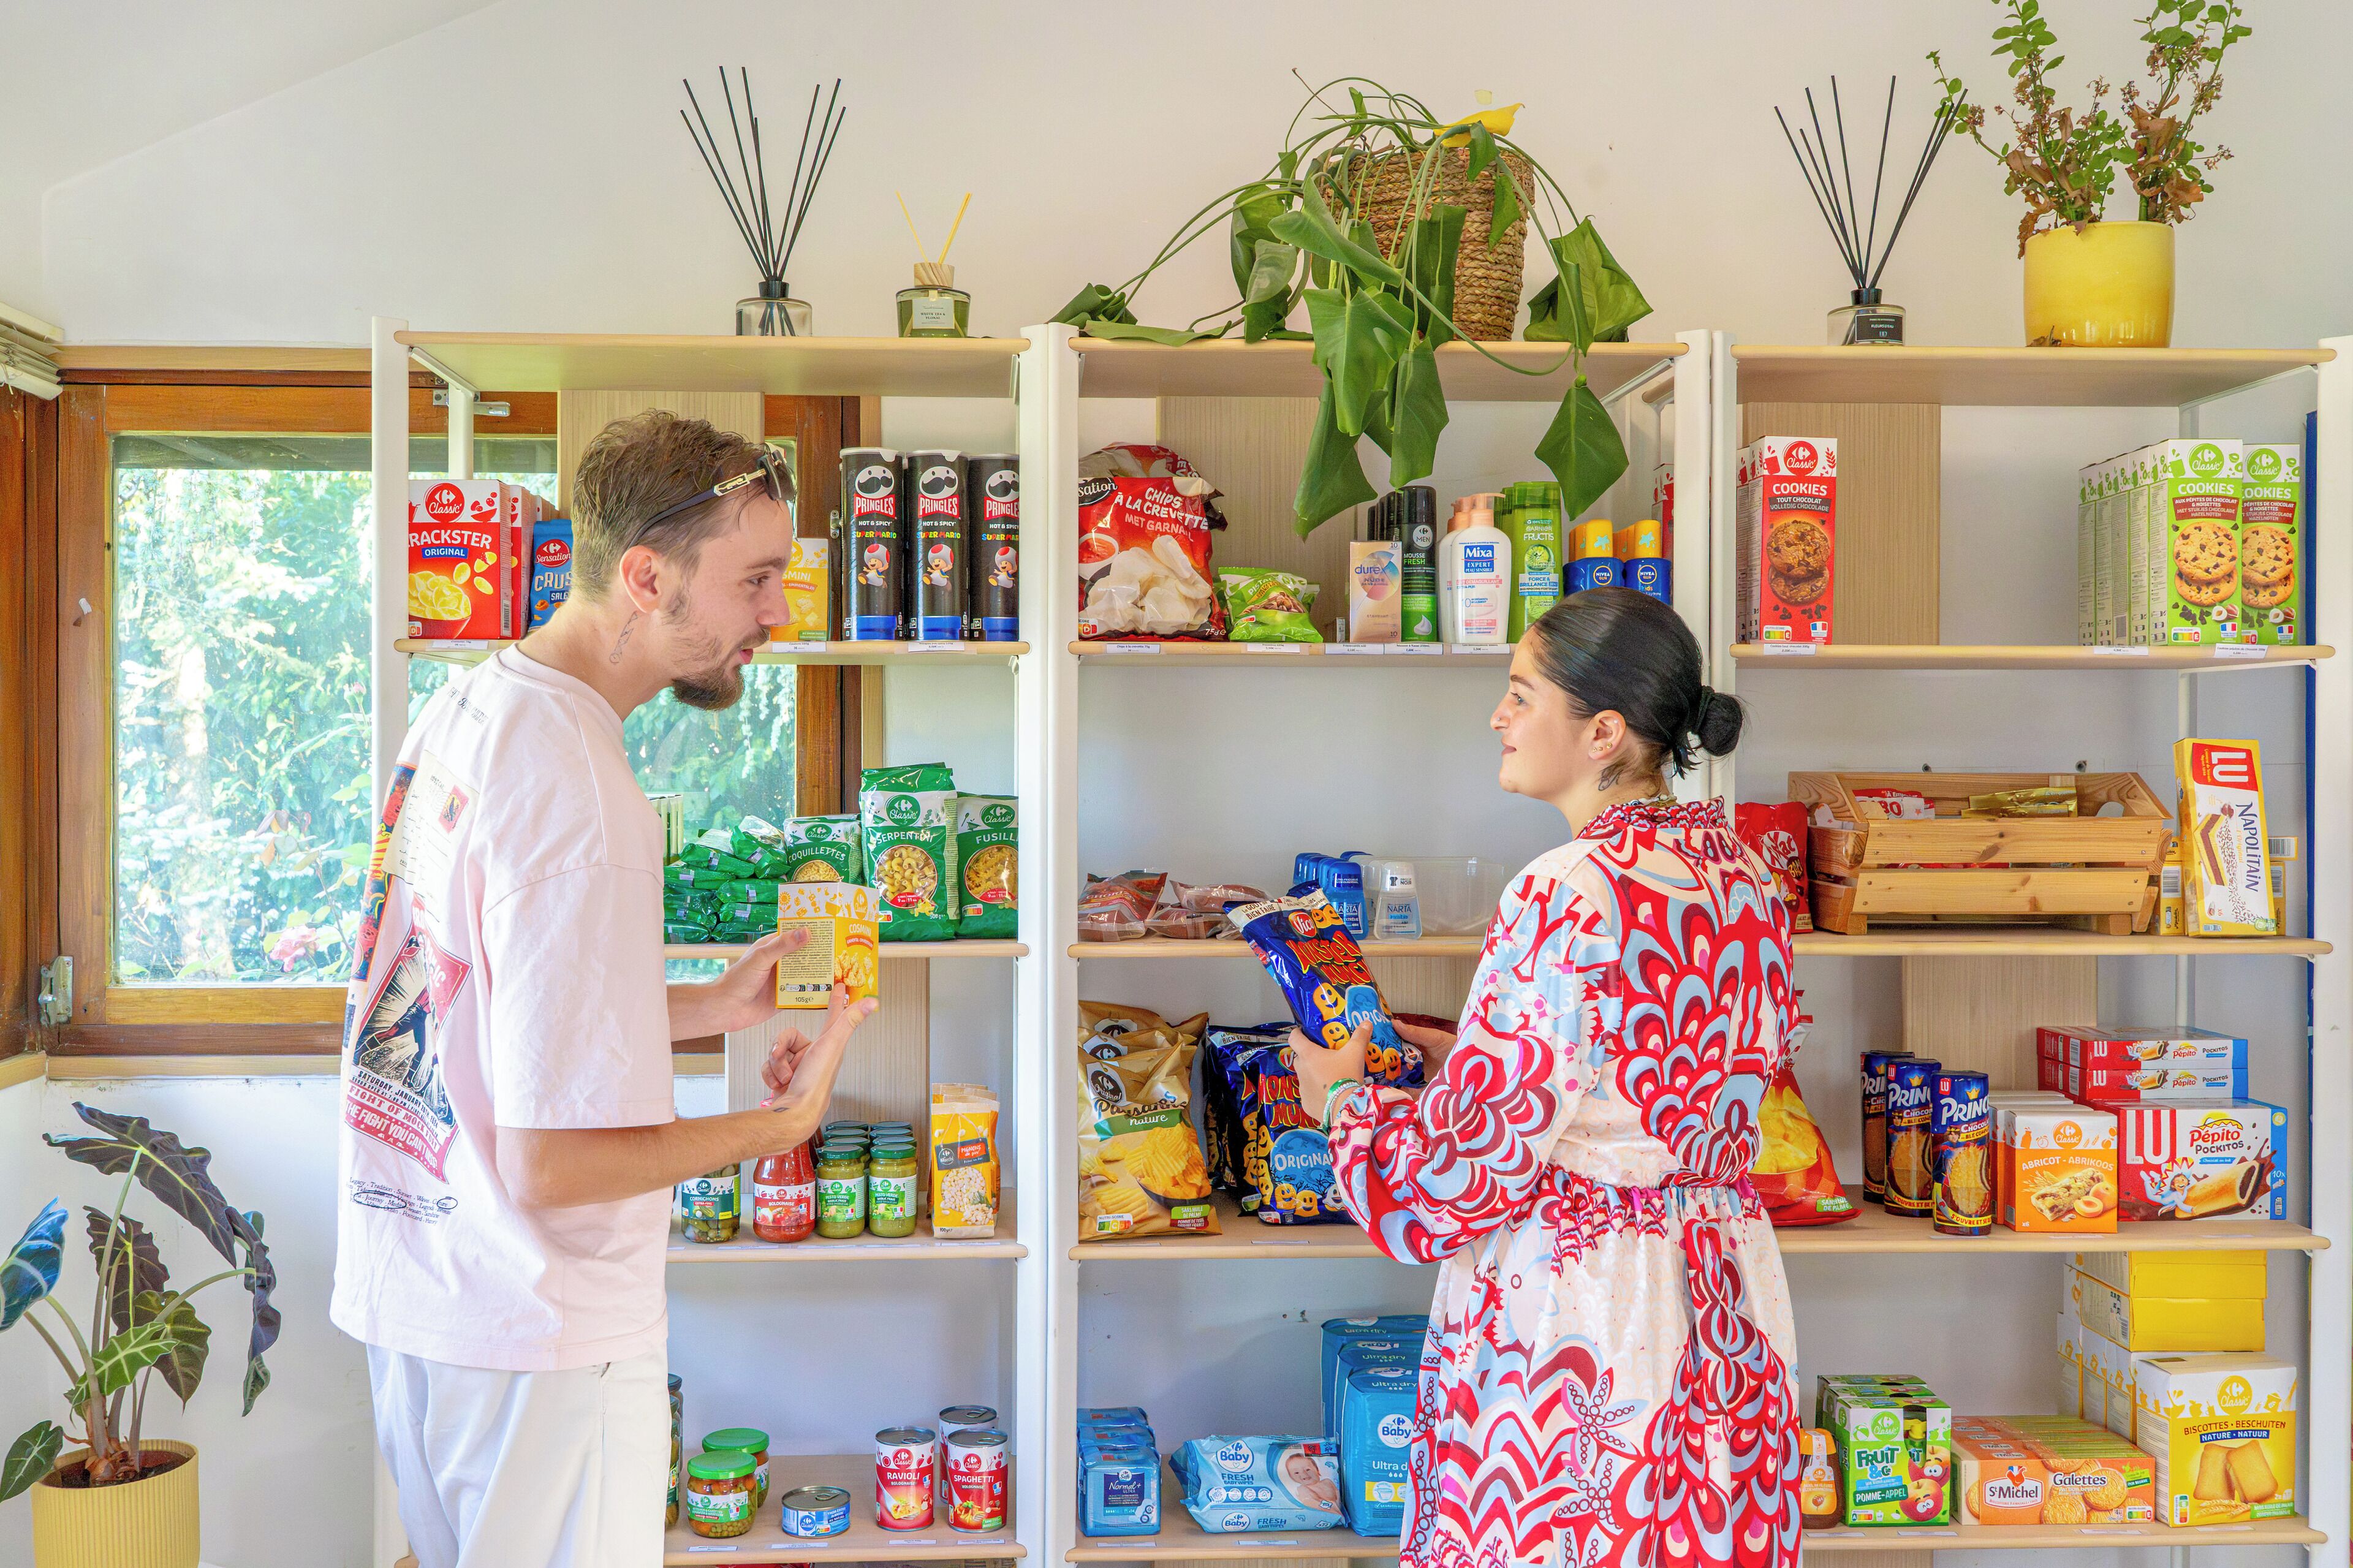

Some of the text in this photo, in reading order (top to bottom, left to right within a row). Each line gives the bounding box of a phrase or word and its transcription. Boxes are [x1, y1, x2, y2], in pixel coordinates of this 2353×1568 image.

[1787, 457, 1816, 469] Classic
[2192, 461, 2222, 471] Classic
[2250, 466, 2279, 475] Classic
[1773, 483, 1827, 496] COOKIES
[2178, 483, 2234, 494] COOKIES
[2242, 487, 2292, 499] OOKIES
[1145, 487, 1182, 509] CHIPS
[429, 503, 461, 514] Classic
[856, 497, 893, 515] PRINGLES
[920, 497, 957, 516] PRINGLES
[1115, 491, 1208, 531] À LA CREVETTE
[1125, 513, 1144, 528] MET
[409, 529, 492, 549] RACKSTER
[425, 548, 465, 556] ORIGINAL
[536, 553, 571, 564] Sensation
[1466, 547, 1493, 558] Mixa
[1355, 564, 1384, 574] durex
[2211, 751, 2249, 783] LU
[890, 811, 918, 820] Classic
[984, 815, 1012, 824] Classic
[789, 846, 846, 863] COQUILLETTES
[1246, 904, 1276, 920] BIEN FAIRE
[849, 924, 872, 937] COSMINI
[1294, 916, 1314, 934] Vico
[2093, 1040, 2107, 1057] LU
[2173, 1048, 2197, 1059] Pépito
[2202, 1045, 2228, 1053] POCKITOS
[1888, 1066, 1896, 1077] LU
[2093, 1070, 2107, 1086] LU
[2172, 1077, 2196, 1088] Pépito
[2202, 1074, 2228, 1083] POCKITOS
[368, 1085, 380, 1093] OPEN
[1094, 1084, 1122, 1100] Original
[1941, 1080, 1949, 1092] LU
[395, 1089, 421, 1108] JANUARY
[349, 1086, 425, 1134] FIGHT OF MOCK
[1940, 1095, 1990, 1125] PRINC
[358, 1110, 389, 1134] FIGHT
[388, 1121, 409, 1143] YOU
[1129, 1114, 1168, 1126] nature
[2056, 1134, 2080, 1145] Classic
[2126, 1109, 2171, 1165] LU
[2189, 1127, 2241, 1148] Pépito
[2196, 1140, 2244, 1154] POCKITOS
[2021, 1156, 2113, 1171] ABRICOT ABRIKOOS
[350, 1177, 412, 1199] Legacy Tradition Sunset
[1950, 1214, 1976, 1225] S'OUVRE
[2220, 1395, 2249, 1407] Classic
[1382, 1426, 1411, 1439] Baby
[2184, 1420, 2286, 1434] BISCOTTES BESCHUITEN
[2202, 1430, 2268, 1441] NATURE NATUUR
[1220, 1450, 1249, 1464] Baby
[1373, 1461, 1399, 1471] Ultra
[954, 1474, 994, 1483] SPAGHETTI
[2053, 1473, 2107, 1487] Galettes
[1855, 1488, 1907, 1502] POMME-APPEL
[1998, 1486, 2038, 1499] Michel
